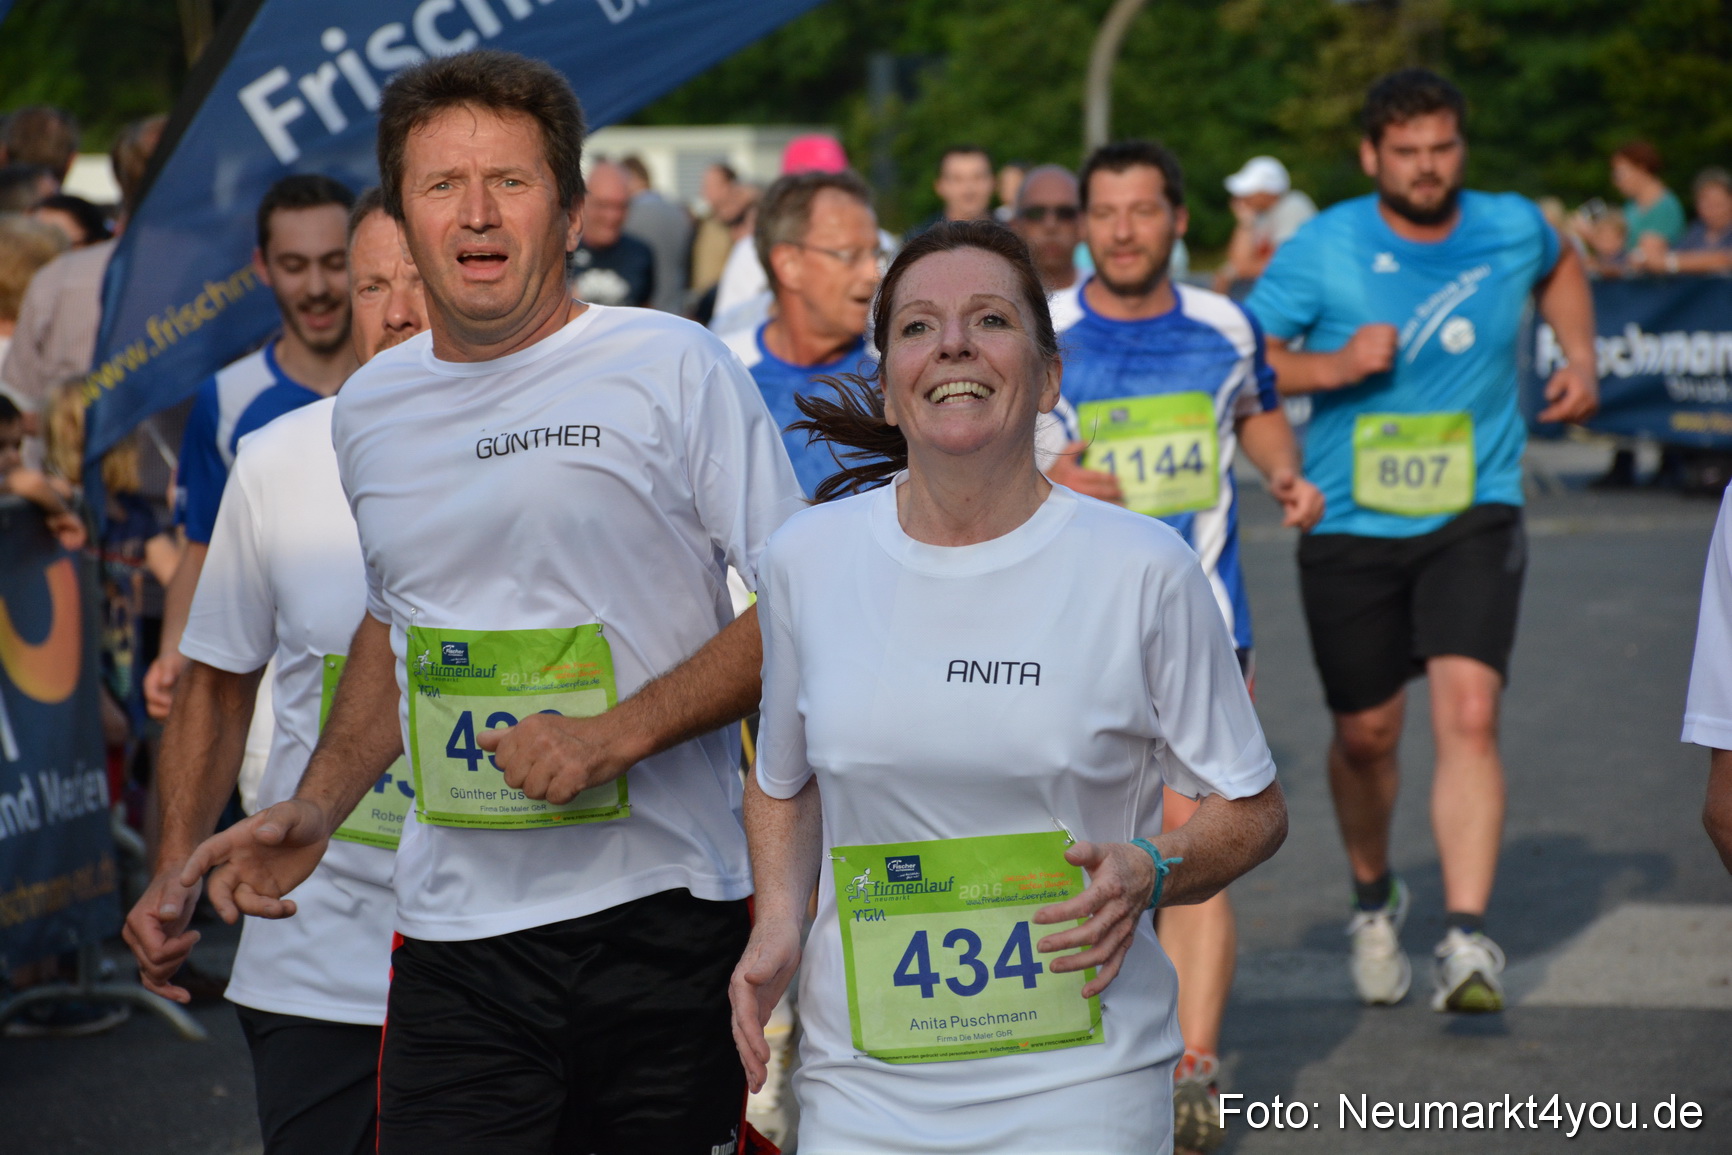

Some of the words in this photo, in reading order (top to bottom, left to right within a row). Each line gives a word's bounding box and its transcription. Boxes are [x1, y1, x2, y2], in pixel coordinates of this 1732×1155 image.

[476, 425, 600, 459] GÜNTHER
[1101, 440, 1205, 483] 1144
[1378, 455, 1450, 489] 807
[430, 663, 498, 678] firmenlauf
[501, 671, 541, 686] 2016
[946, 659, 1041, 686] ANITA
[450, 786, 497, 800] Günther
[531, 804, 547, 812] GbR
[874, 876, 954, 897] firmenlauf
[959, 882, 1003, 900] 2016
[874, 895, 911, 903] neumarkt
[893, 921, 1043, 999] 434
[910, 1016, 947, 1031] Anita
[950, 1010, 1038, 1028] Puschmann
[937, 1035, 958, 1043] Firma
[959, 1033, 972, 1042] Die
[995, 1029, 1014, 1038] GbR
